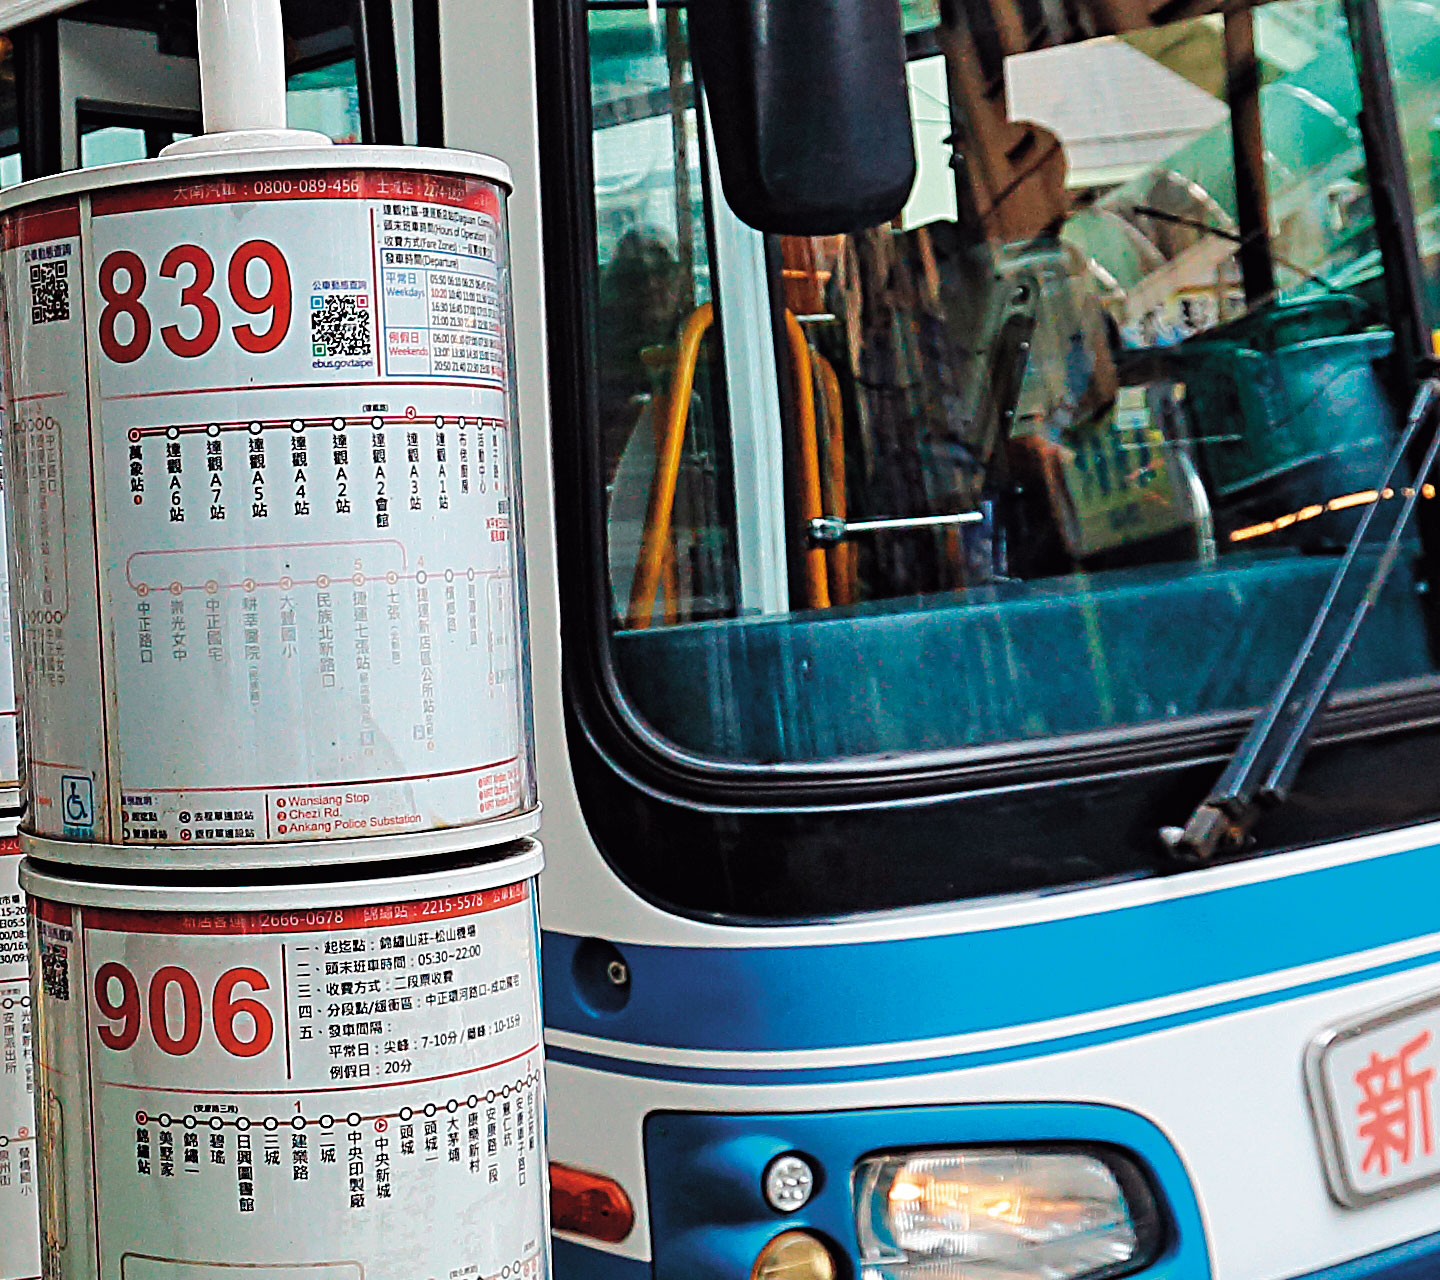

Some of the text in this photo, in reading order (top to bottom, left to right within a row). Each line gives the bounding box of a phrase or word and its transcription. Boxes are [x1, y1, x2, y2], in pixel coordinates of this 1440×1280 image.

[97, 238, 293, 364] 839
[137, 601, 153, 663] 中正路口
[289, 807, 343, 821] Chezi Rd.
[346, 793, 370, 806] Stop
[289, 813, 422, 834] Ankang Police Substation
[93, 961, 274, 1057] 906
[294, 1101, 301, 1113] 1
[264, 1134, 280, 1166] 三城
[320, 1132, 336, 1163] 二城
[375, 1137, 391, 1198] 中央新城
